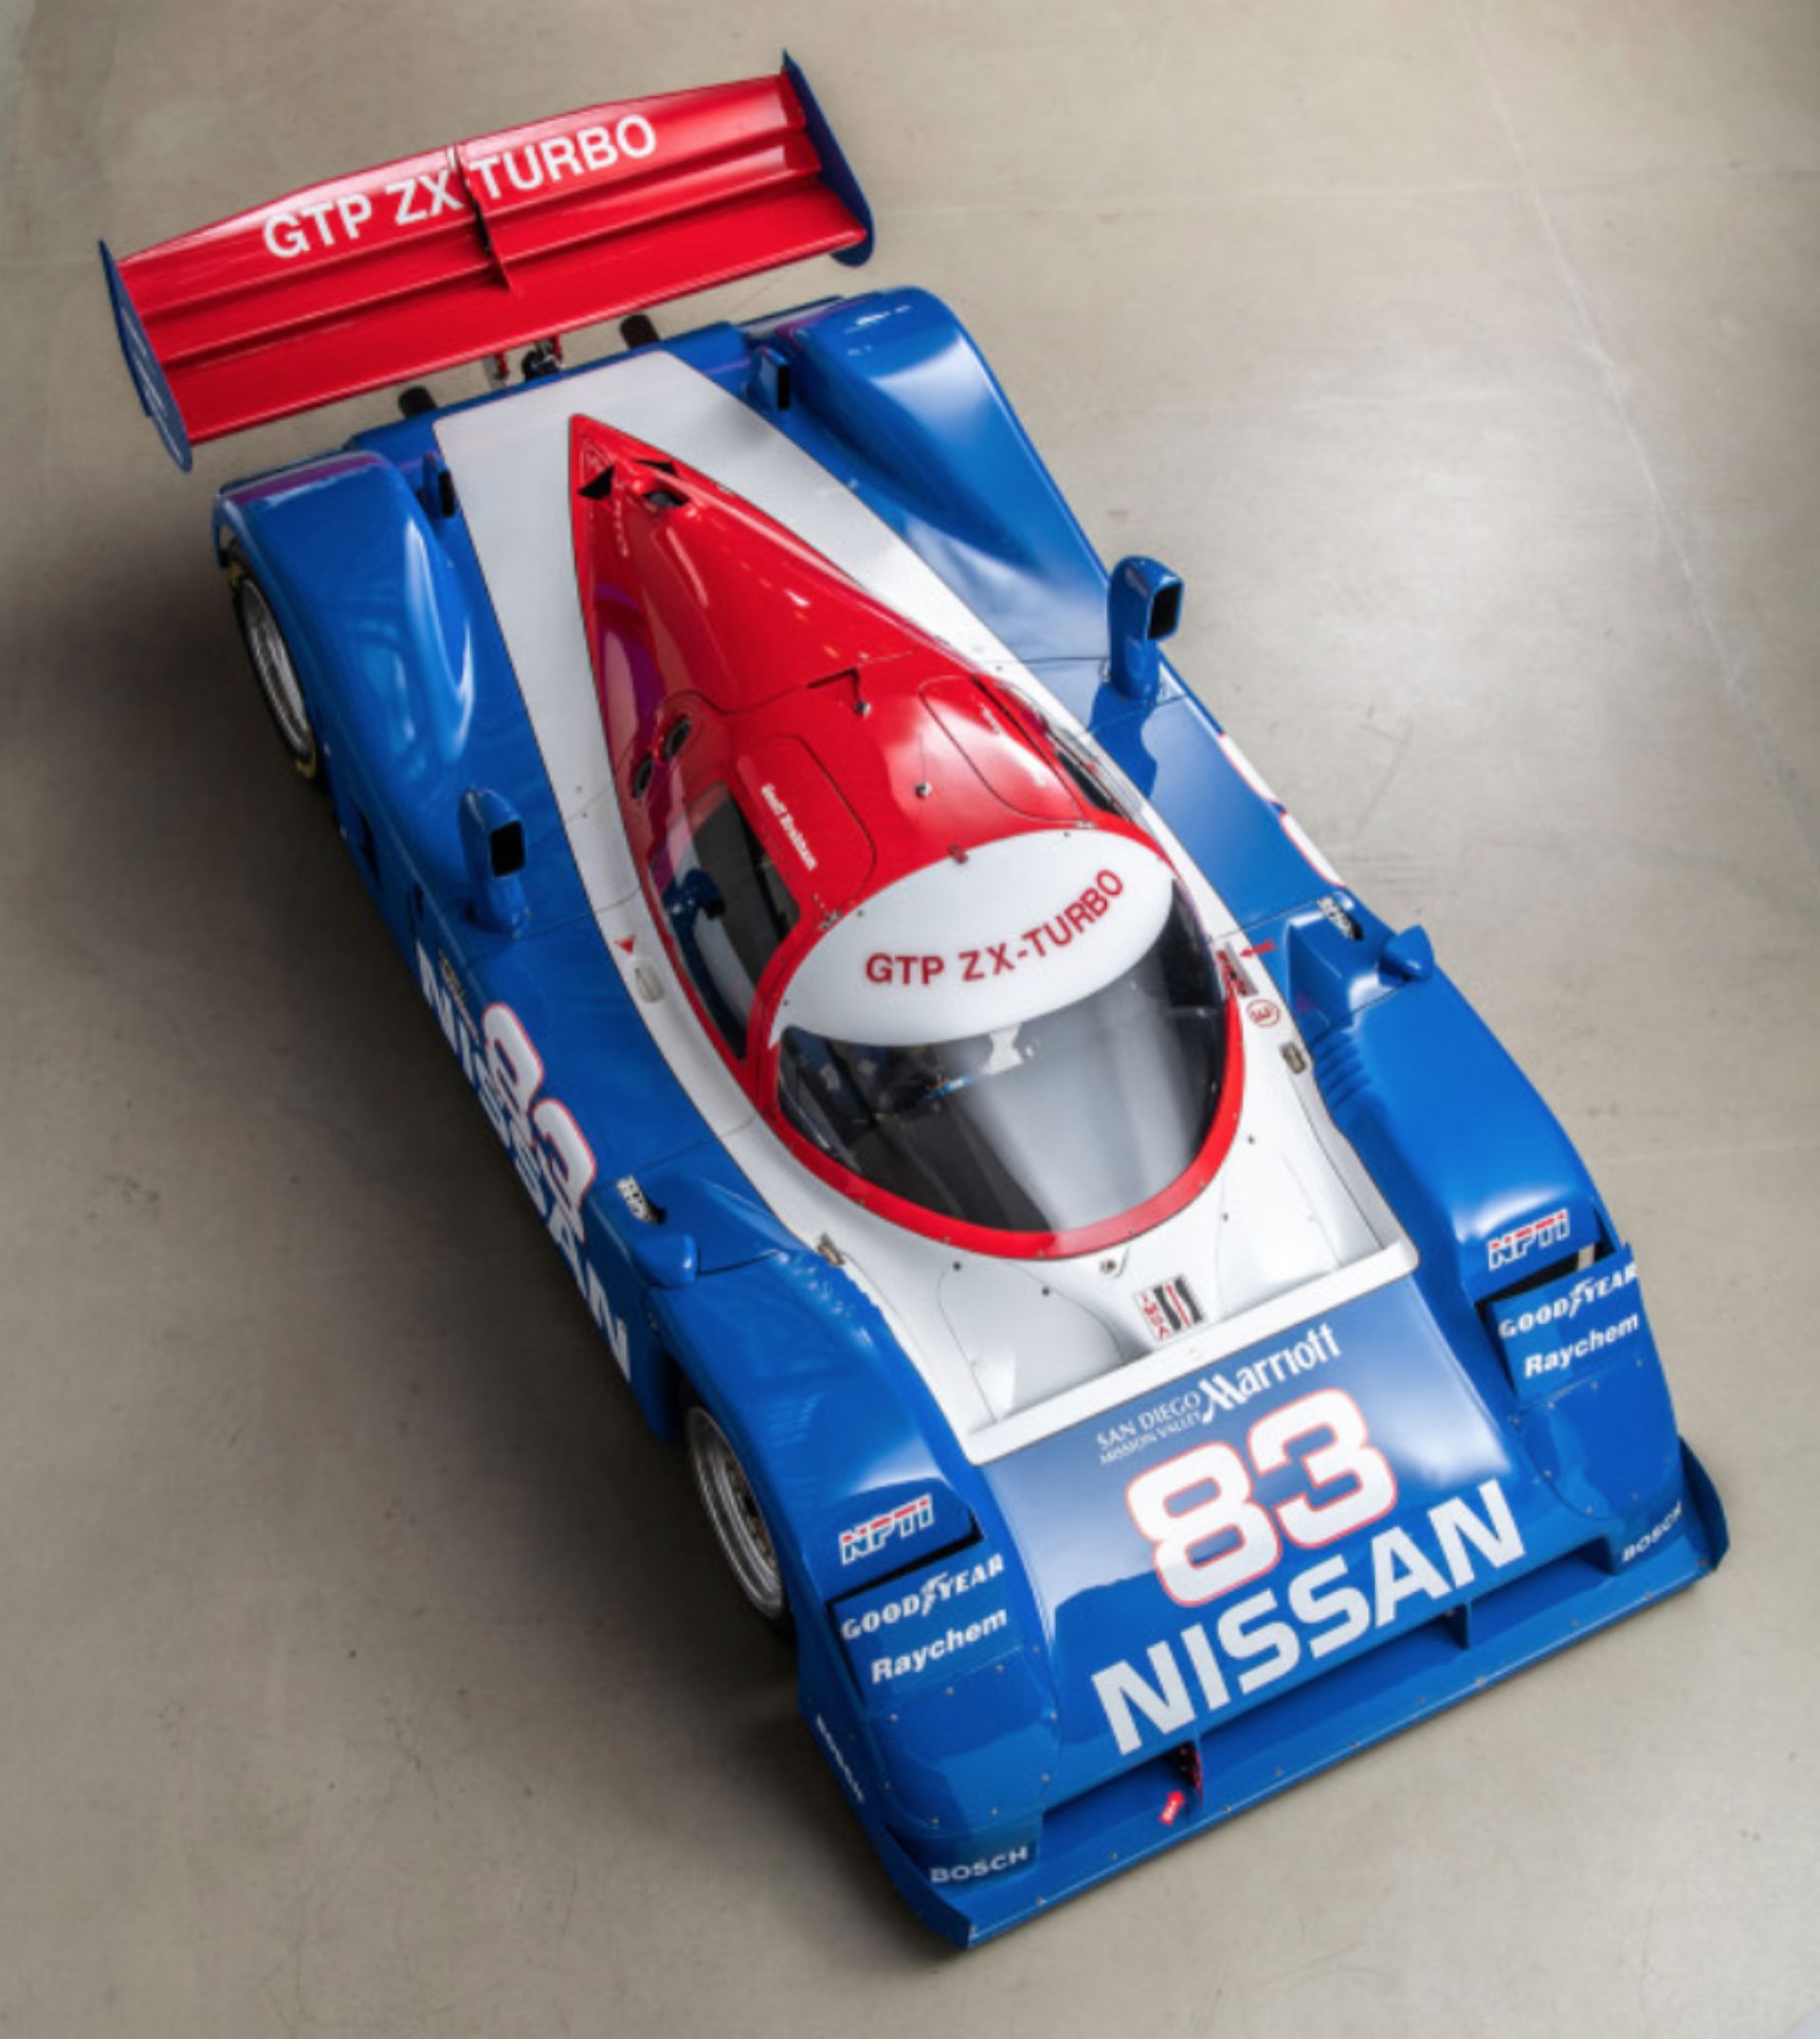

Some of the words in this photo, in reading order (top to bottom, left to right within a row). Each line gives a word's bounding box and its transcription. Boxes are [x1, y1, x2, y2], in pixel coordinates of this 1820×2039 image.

[264, 191, 374, 258] GTP
[385, 170, 464, 225] ZX
[469, 113, 657, 199] TURBO
[864, 952, 945, 985] GTP
[1498, 1261, 1638, 1339] GOODYEAR
[1097, 1420, 1137, 1451] SAN
[1138, 1389, 1202, 1431] DIEGO
[1198, 1323, 1341, 1425] Marriott
[1524, 1313, 1639, 1379] Raychem
[1125, 1387, 1398, 1608] 83
[841, 1552, 1006, 1641] GOODYEAR
[1090, 1478, 1527, 1757] NISSAN
[871, 1609, 1009, 1685] Raychem
[930, 1846, 1028, 1884] BOSCH
